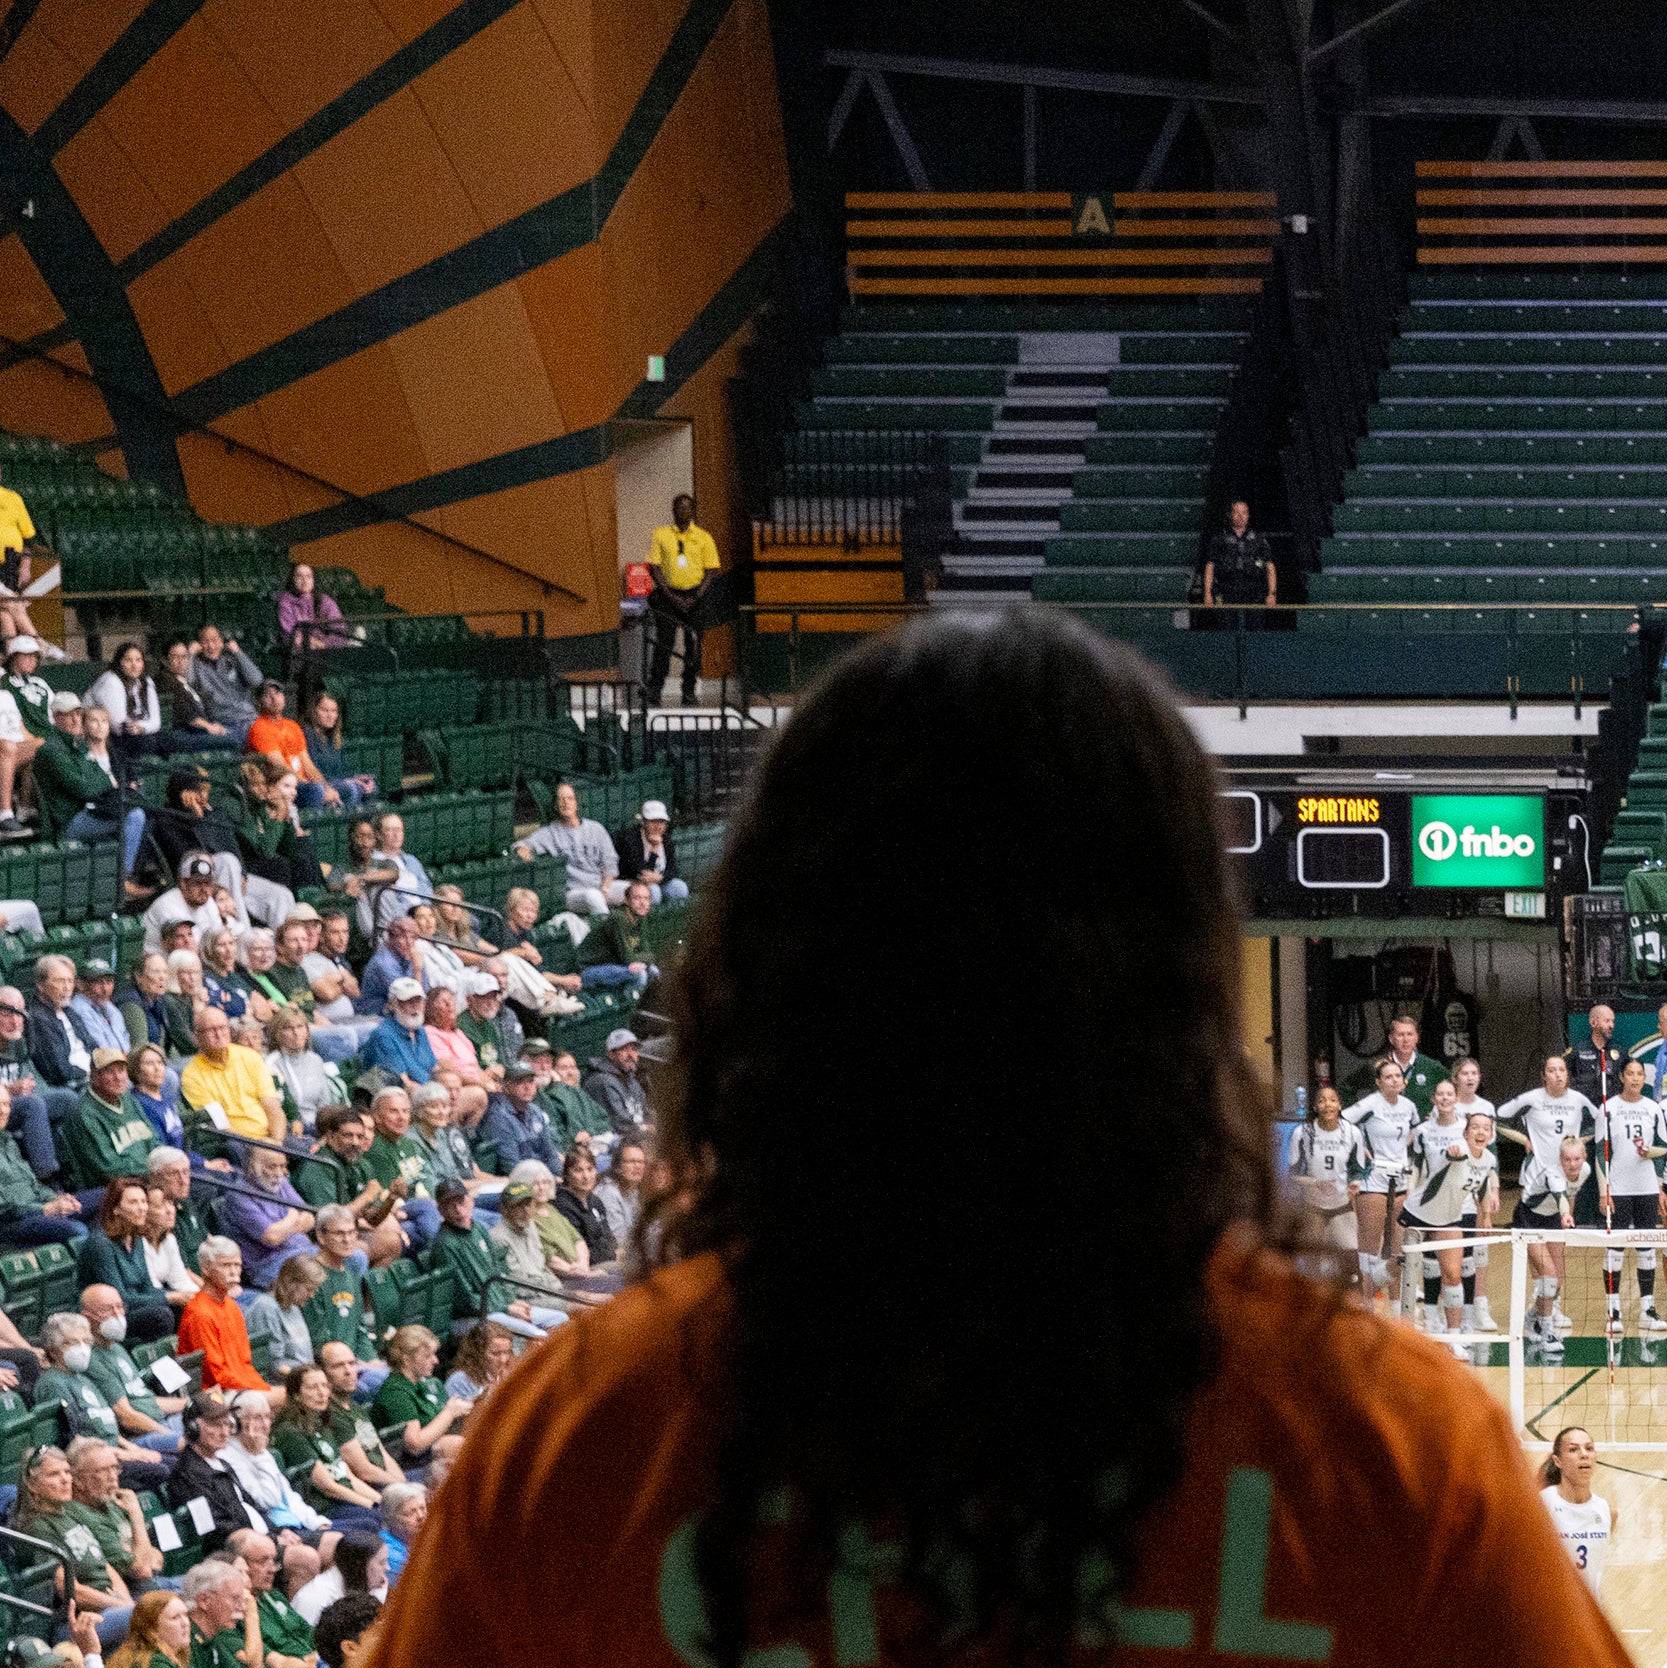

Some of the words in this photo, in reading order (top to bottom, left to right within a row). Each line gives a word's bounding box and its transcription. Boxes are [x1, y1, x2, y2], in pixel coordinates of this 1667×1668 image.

[1077, 198, 1110, 235] A
[1298, 798, 1380, 823] SPARTANS
[1460, 825, 1535, 857] fnbo
[1513, 892, 1538, 914] EXIT
[1554, 1119, 1565, 1135] 3
[1625, 1124, 1643, 1139] 13
[1324, 1155, 1335, 1170] 9
[1575, 1545, 1588, 1570] 3
